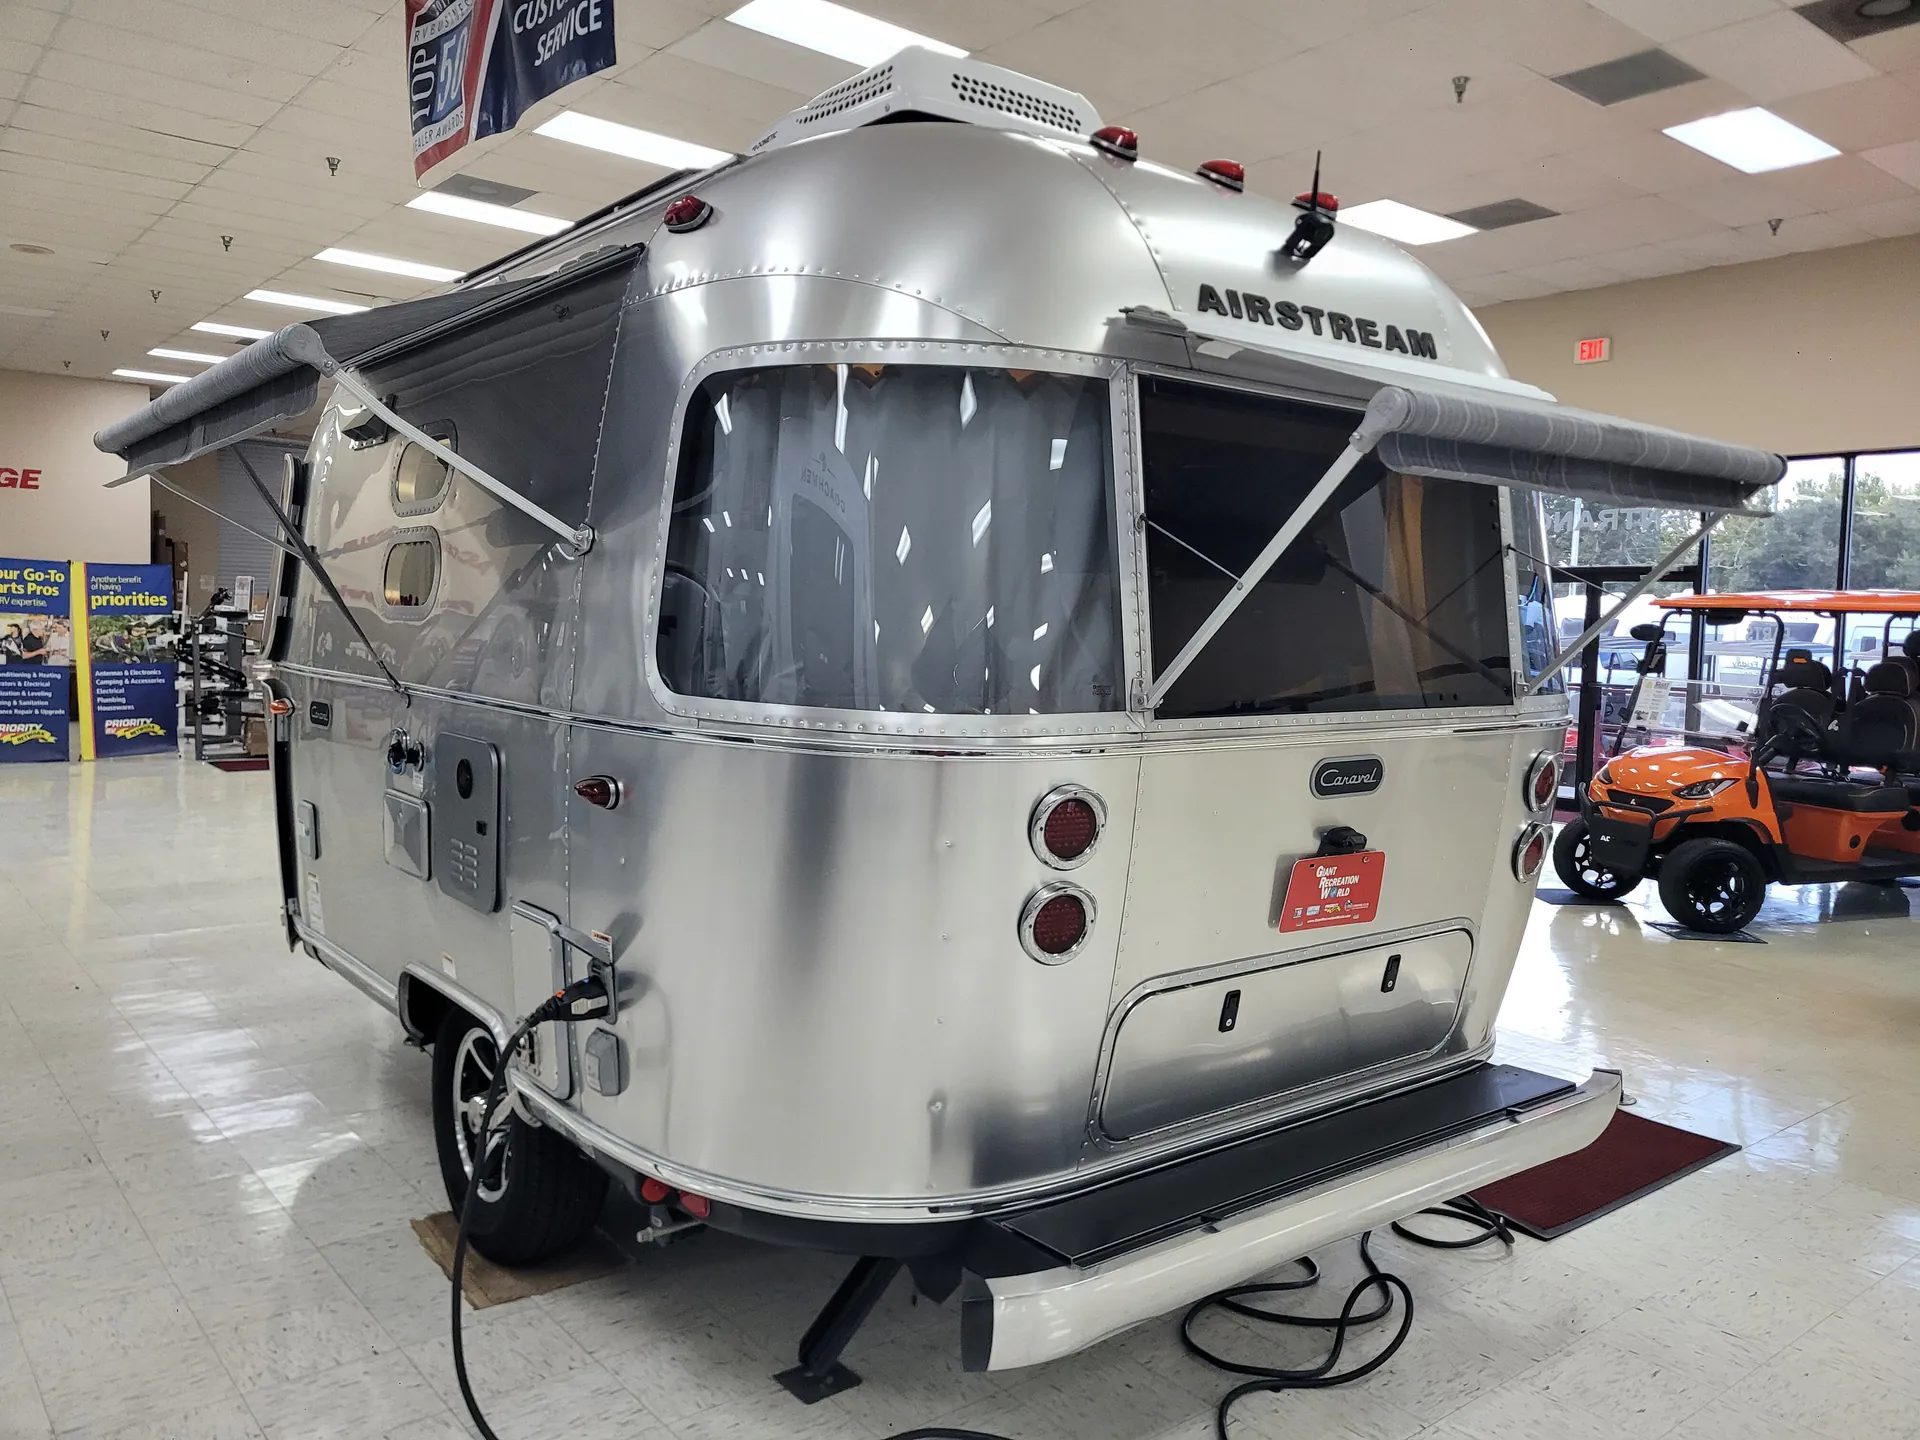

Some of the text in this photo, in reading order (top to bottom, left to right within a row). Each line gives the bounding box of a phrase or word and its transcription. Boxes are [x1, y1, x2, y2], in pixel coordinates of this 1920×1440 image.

[534, 0, 602, 67] SERVICE
[437, 26, 468, 112] 50
[411, 48, 437, 130] TOP
[435, 110, 464, 137] AWARDS
[1197, 283, 1438, 360] AIRSTREAM
[1580, 339, 1604, 360] EXIT
[23, 568, 65, 583] Go-To
[118, 576, 142, 584] benefit
[27, 582, 60, 597] Pros
[91, 583, 122, 592] of having
[11, 598, 48, 608] expertise.
[91, 591, 168, 610] priorities
[38, 672, 62, 680] Heating
[27, 690, 53, 698] Leveling
[13, 708, 33, 716] Repair
[40, 708, 65, 716] Upgrade
[105, 717, 153, 728] PRIORITY
[1320, 768, 1377, 787] Caravel
[1316, 866, 1337, 878] GIANT
[1318, 875, 1360, 888] RECREATION
